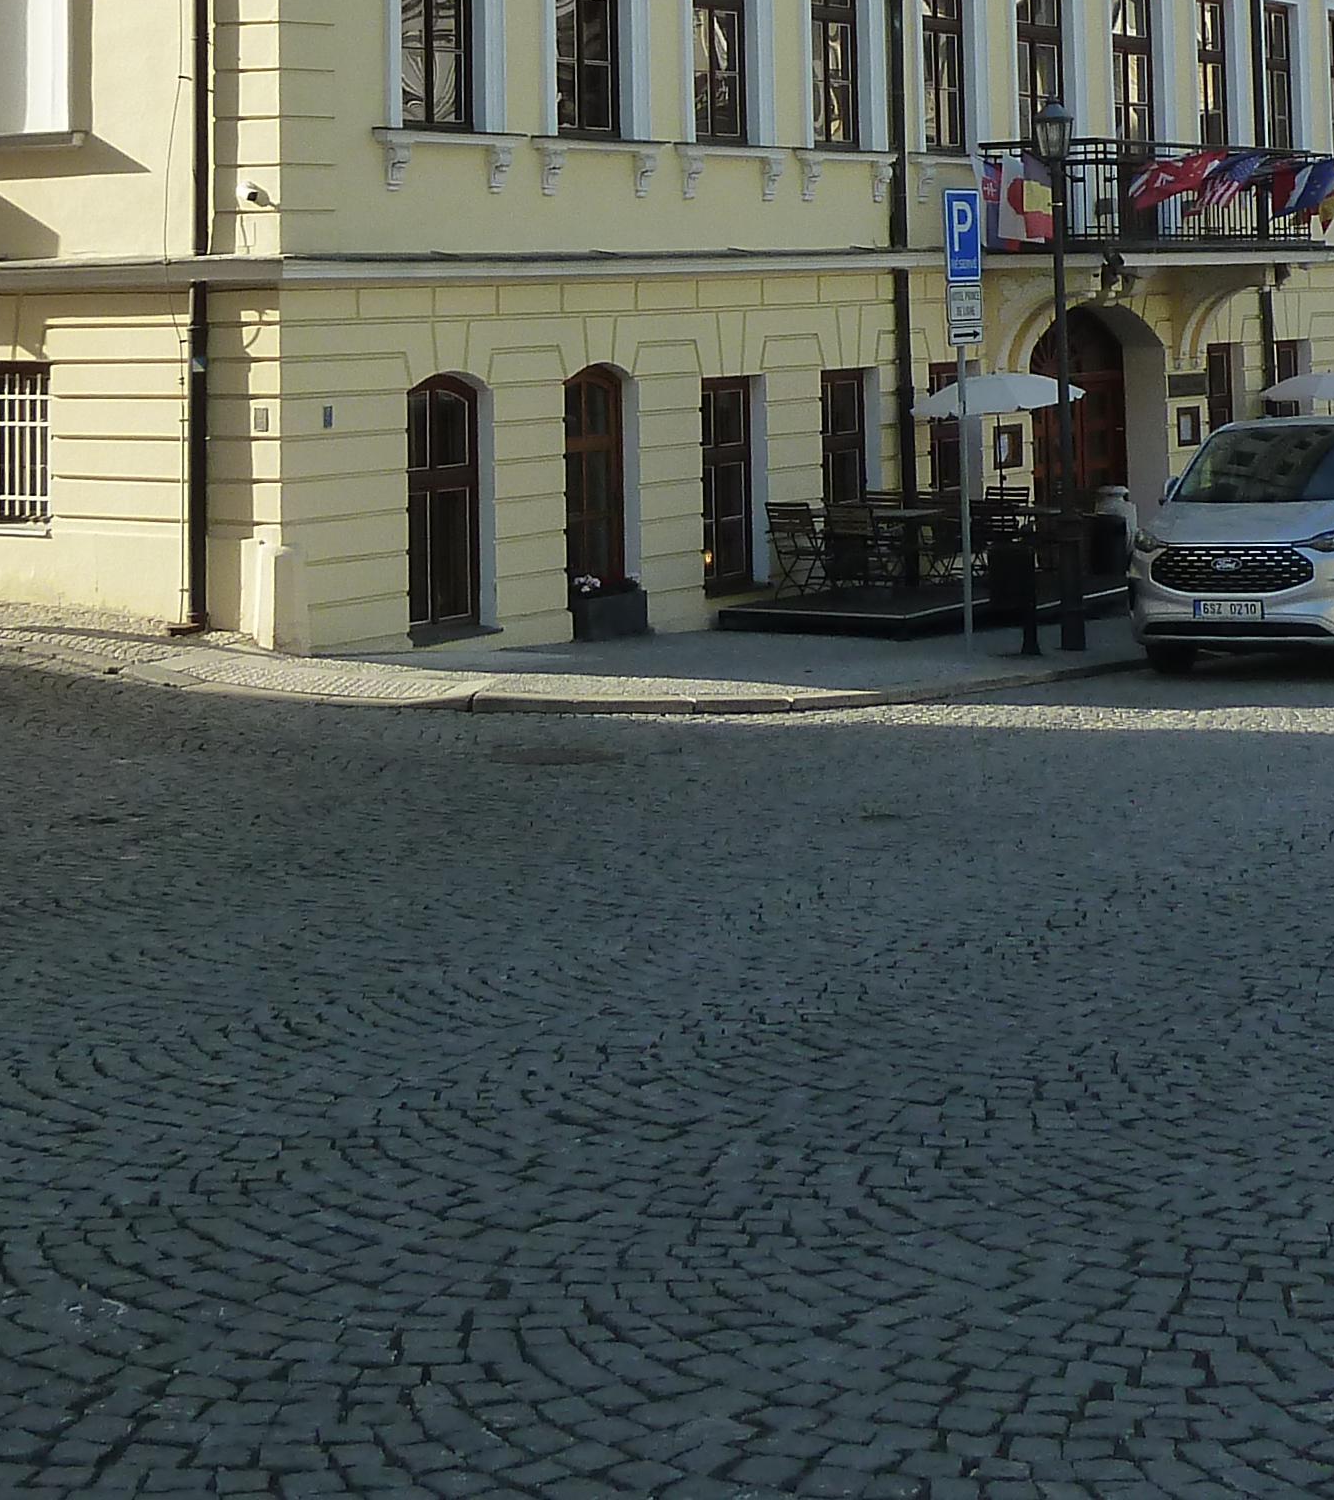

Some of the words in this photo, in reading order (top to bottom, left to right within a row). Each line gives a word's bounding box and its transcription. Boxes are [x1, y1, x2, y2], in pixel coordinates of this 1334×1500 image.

[952, 201, 972, 252] P
[1203, 603, 1222, 615] 6SZ
[1230, 603, 1256, 615] 0210
